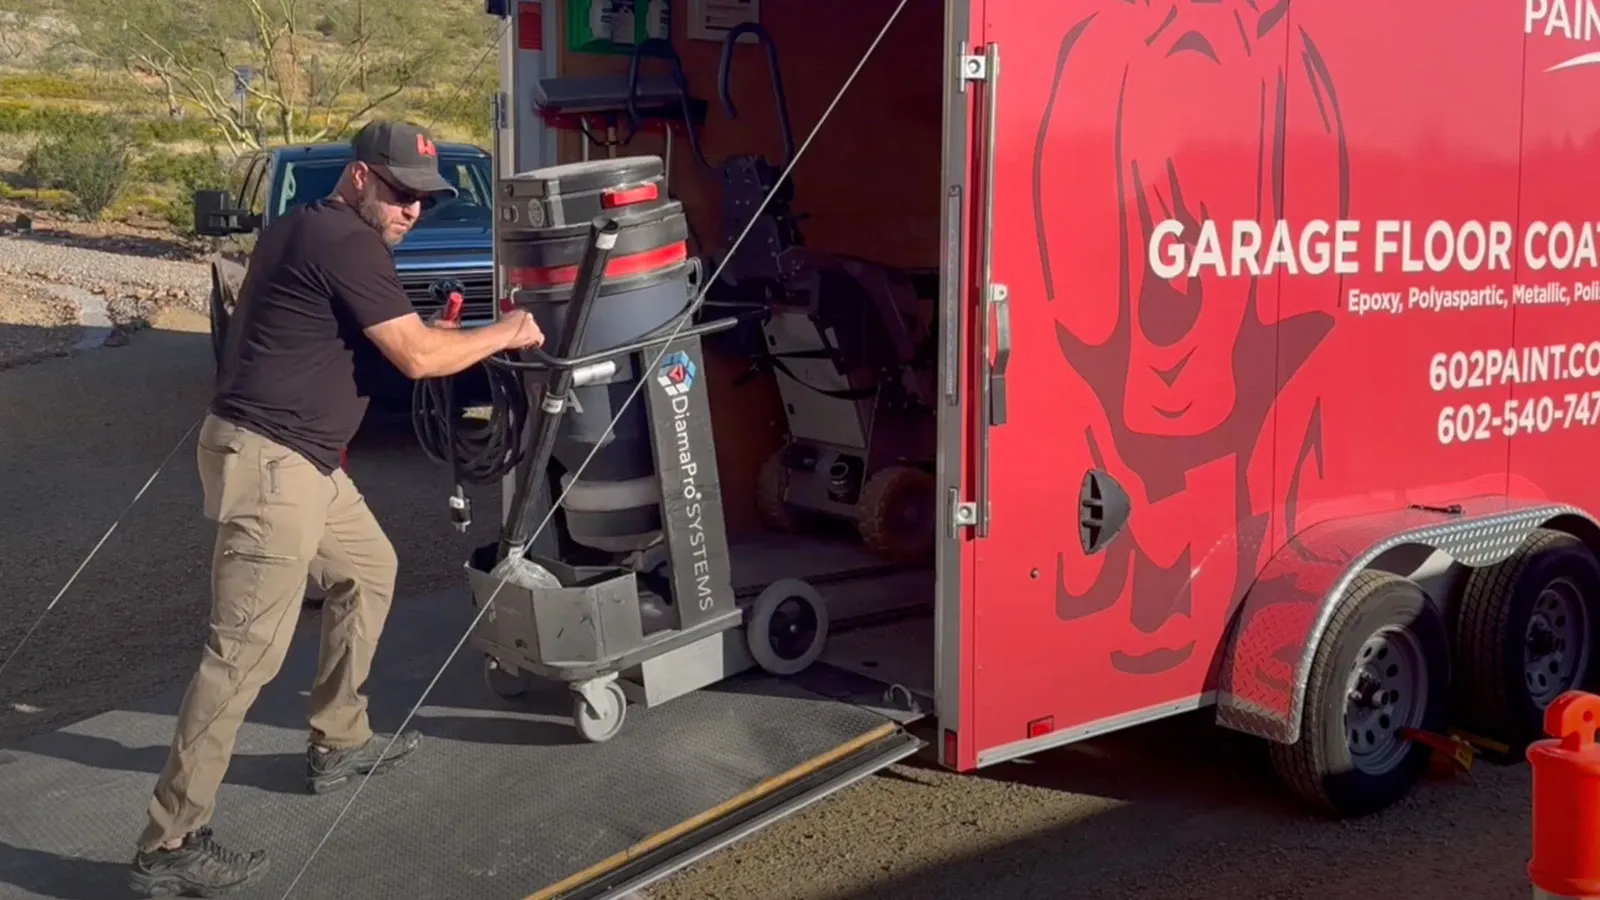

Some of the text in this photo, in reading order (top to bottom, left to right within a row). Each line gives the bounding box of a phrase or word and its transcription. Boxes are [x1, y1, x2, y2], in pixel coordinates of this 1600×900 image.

[1525, 0, 1600, 41] PAIN
[1149, 219, 1600, 278] GARAGE FLOOR COA
[1348, 288, 1403, 315] Epoxy,
[1408, 284, 1508, 312] Polyaspartic,
[1512, 281, 1570, 306] Metallic,
[1429, 341, 1600, 391] 602PAINT.CO
[1437, 391, 1600, 444] 602-540-747
[686, 503, 714, 611] SYSTEMS
